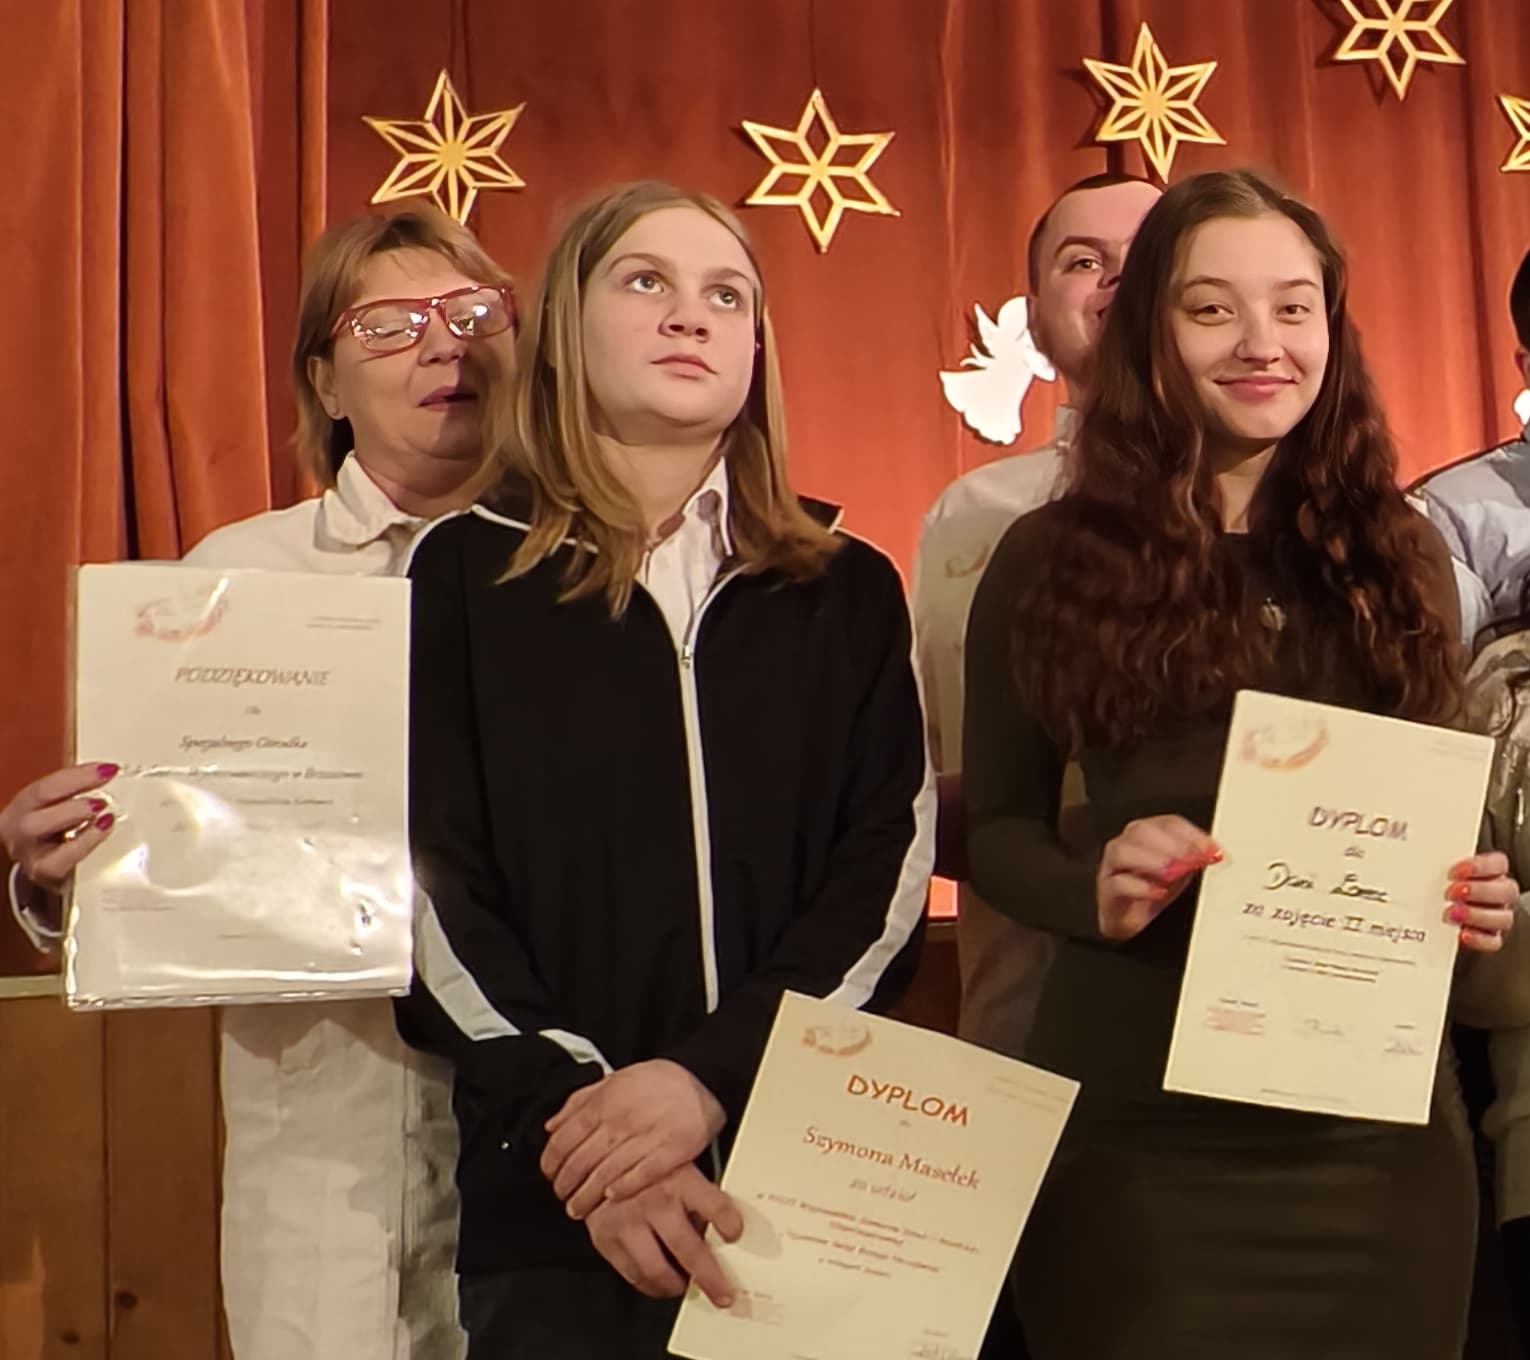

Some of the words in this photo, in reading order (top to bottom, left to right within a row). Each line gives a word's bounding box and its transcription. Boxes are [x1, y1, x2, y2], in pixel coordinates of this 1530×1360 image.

[1309, 806, 1408, 841] DYPLOM
[1343, 915, 1365, 932] II
[846, 1074, 968, 1127] DYPLOM
[803, 1125, 894, 1167] Szymona
